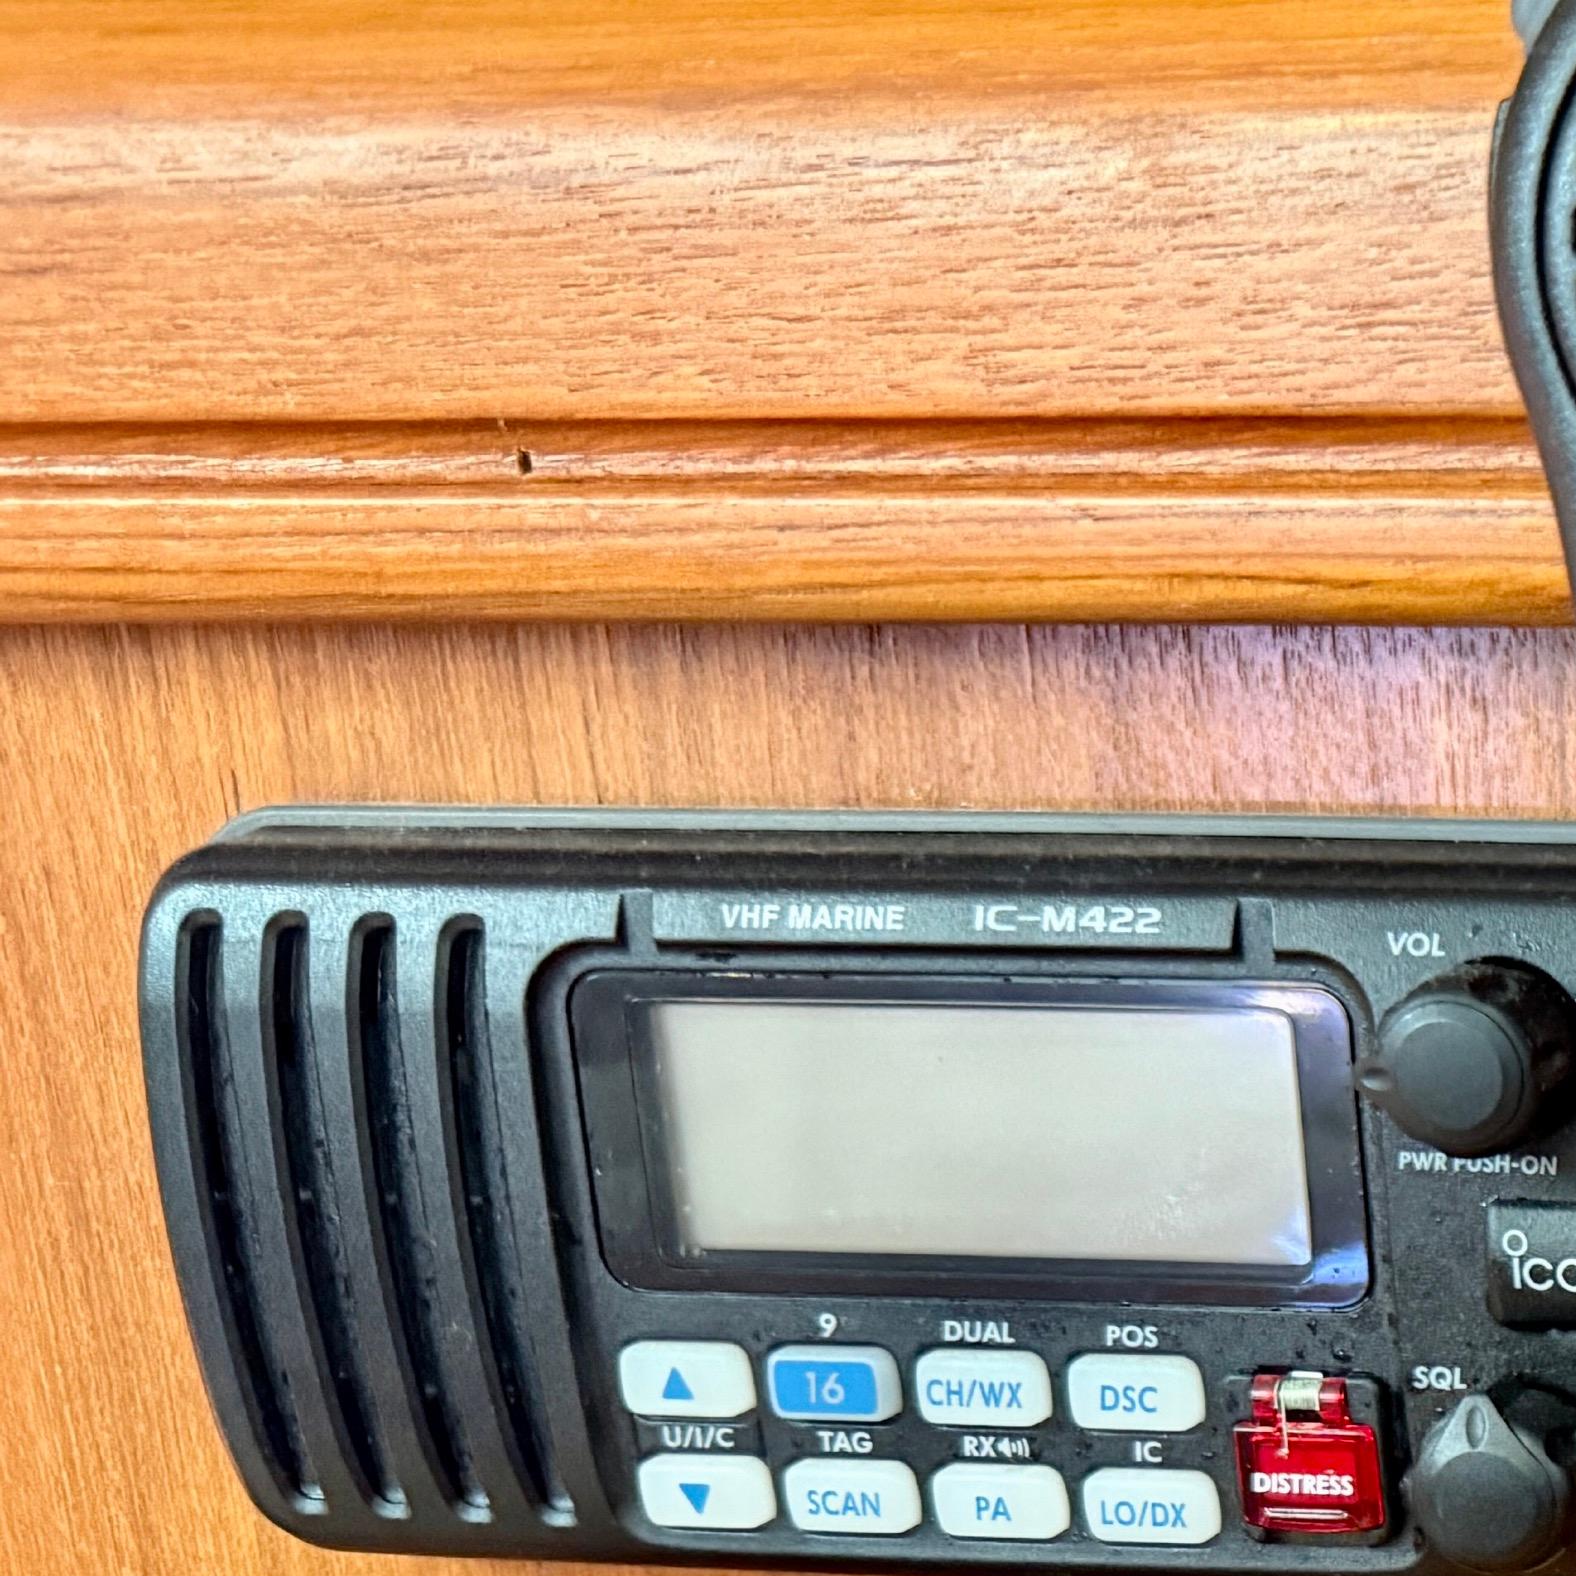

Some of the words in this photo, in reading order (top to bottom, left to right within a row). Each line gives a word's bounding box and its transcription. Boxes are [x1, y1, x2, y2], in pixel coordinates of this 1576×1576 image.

[722, 905, 778, 930] VHF
[787, 906, 906, 931] MARINE
[974, 906, 1162, 934] IC-M422
[1388, 932, 1445, 957] VOL
[1399, 1152, 1447, 1173] PWR
[1453, 1153, 1557, 1176] PUSH-ON
[819, 1313, 837, 1337] 9
[943, 1321, 1015, 1345] DUAL
[1106, 1325, 1159, 1348] POS
[804, 1371, 845, 1404] 16
[1413, 1367, 1467, 1390] SQL
[926, 1379, 1023, 1410] CH/WX
[1100, 1385, 1158, 1414] DSC
[662, 1426, 735, 1448] U/I/C
[817, 1431, 873, 1453] TAG
[963, 1437, 996, 1457] RX
[1134, 1442, 1162, 1463] IC
[1252, 1472, 1355, 1496] DISTRESS
[808, 1490, 881, 1517] SCAN
[976, 1496, 1012, 1522] PA
[1100, 1500, 1186, 1529] LO/DX
